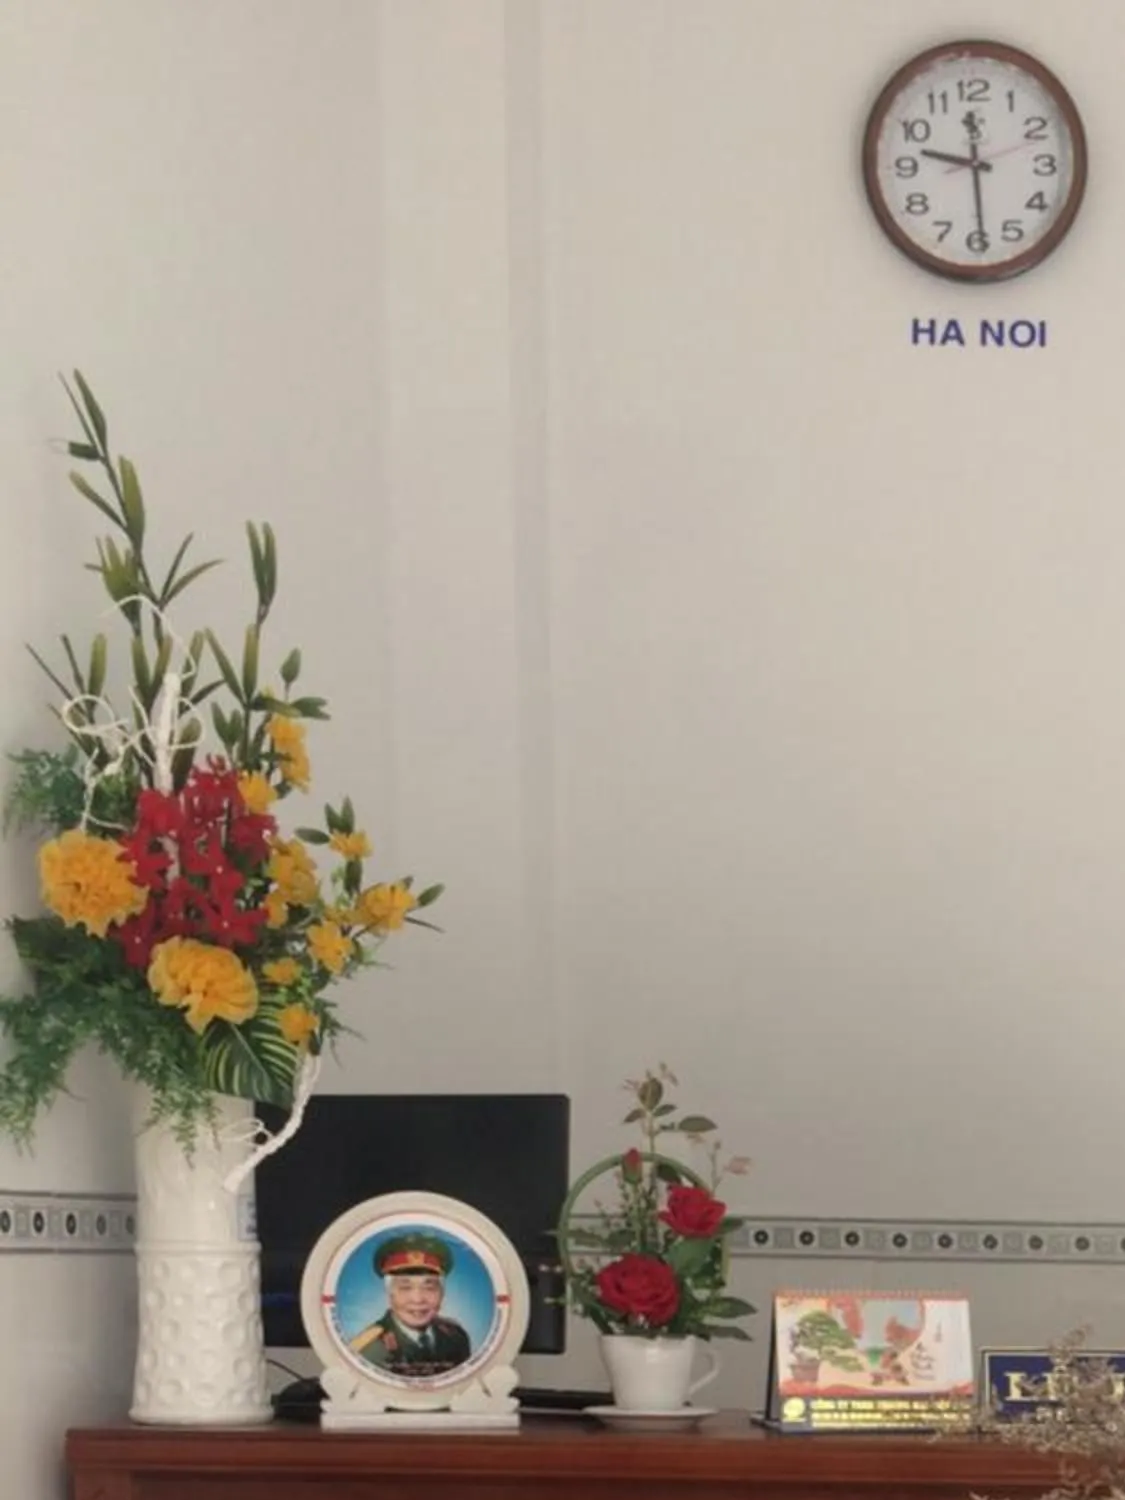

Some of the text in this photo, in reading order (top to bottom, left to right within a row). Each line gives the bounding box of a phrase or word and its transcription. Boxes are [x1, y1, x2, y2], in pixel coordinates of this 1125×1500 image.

[928, 89, 948, 114] 11
[957, 79, 990, 102] 12
[1006, 91, 1014, 112] 1
[902, 119, 930, 142] 10
[1024, 117, 1048, 140] 2
[895, 157, 919, 178] 9
[1033, 155, 1057, 176] 3
[905, 193, 930, 215] 8
[1025, 191, 1048, 212] 4
[932, 221, 953, 242] 7
[965, 230, 990, 254] 6
[1001, 220, 1024, 242] 5
[911, 318, 1046, 348] HA NOI
